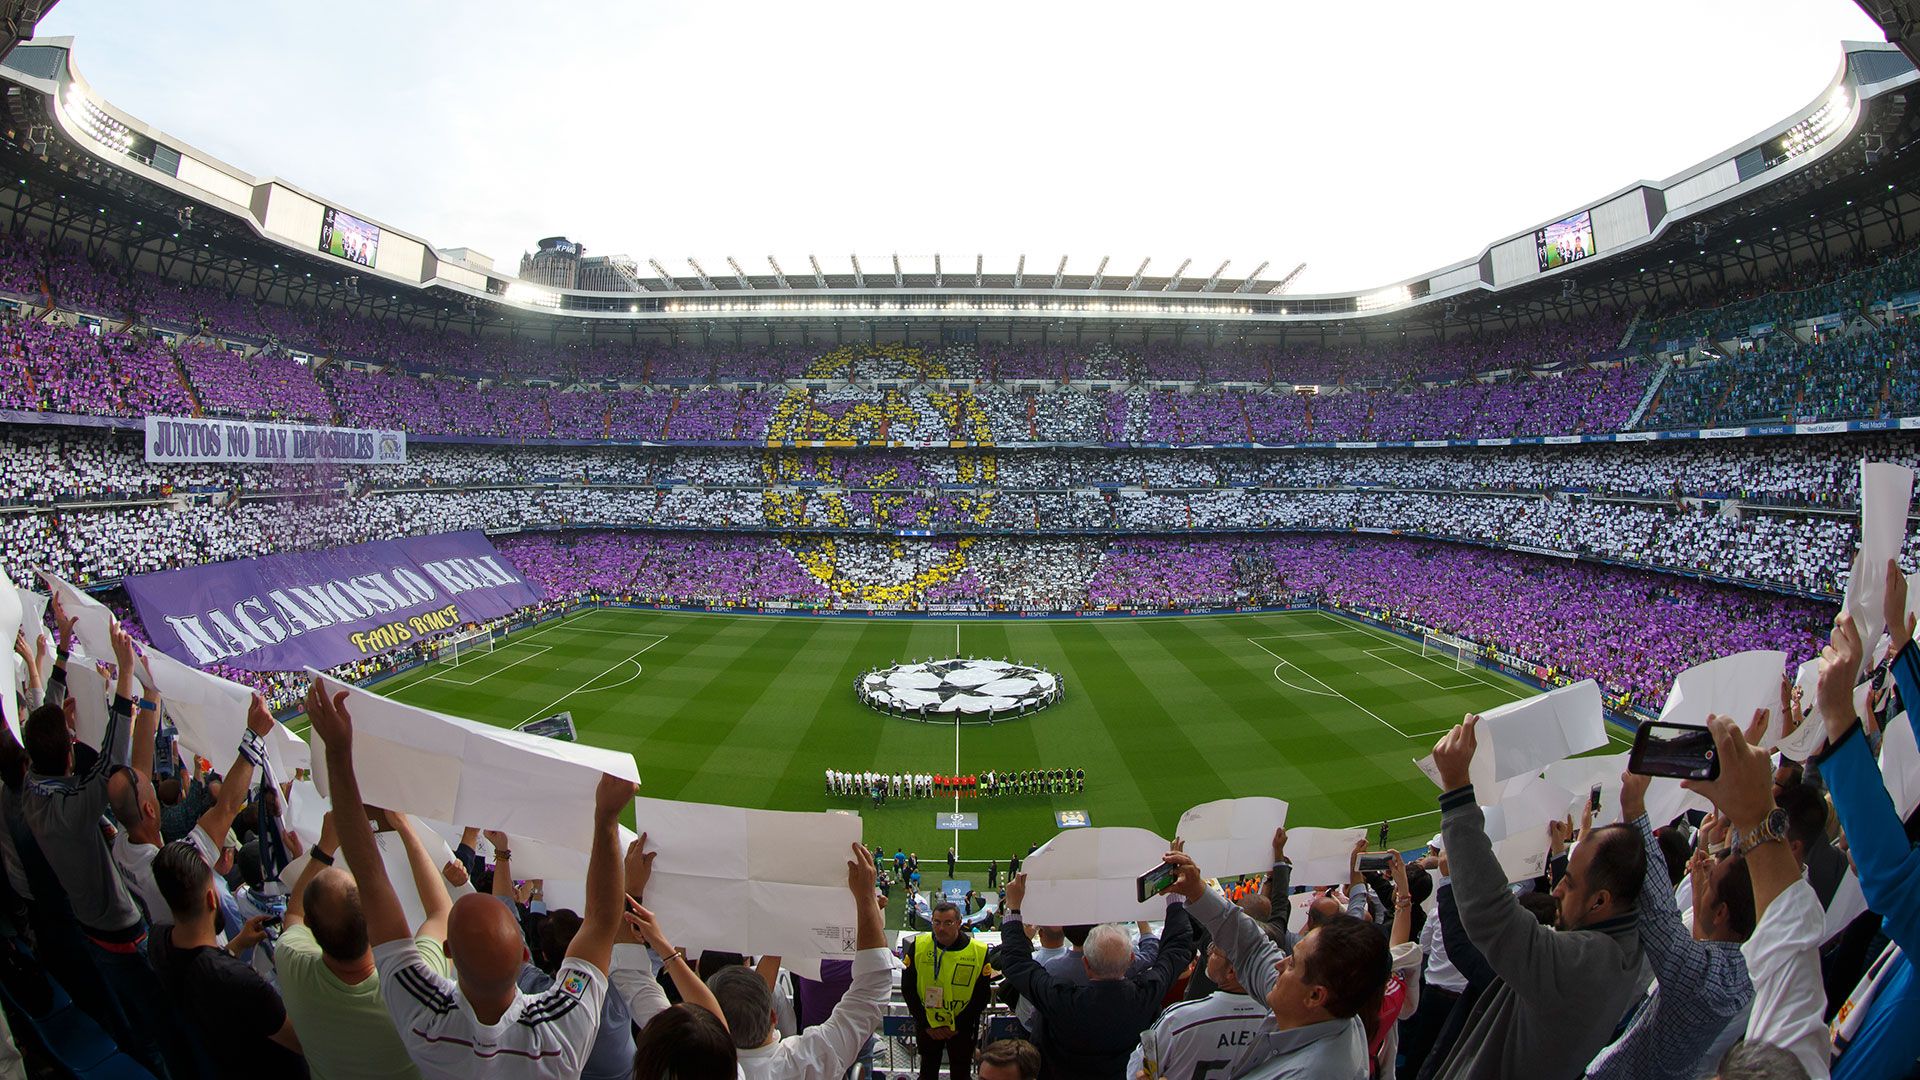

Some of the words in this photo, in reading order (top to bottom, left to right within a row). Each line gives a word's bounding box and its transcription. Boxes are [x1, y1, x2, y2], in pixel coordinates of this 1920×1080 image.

[556, 244, 577, 254] KPMG
[153, 421, 221, 457] JUNTOS
[225, 425, 250, 458] NO
[254, 427, 287, 459] HAY
[292, 430, 375, 460] IMPOSIBLES
[1872, 421, 1886, 429] Madrid
[422, 555, 521, 595] REAL
[350, 621, 412, 654] FANS
[408, 604, 461, 635] RMCF
